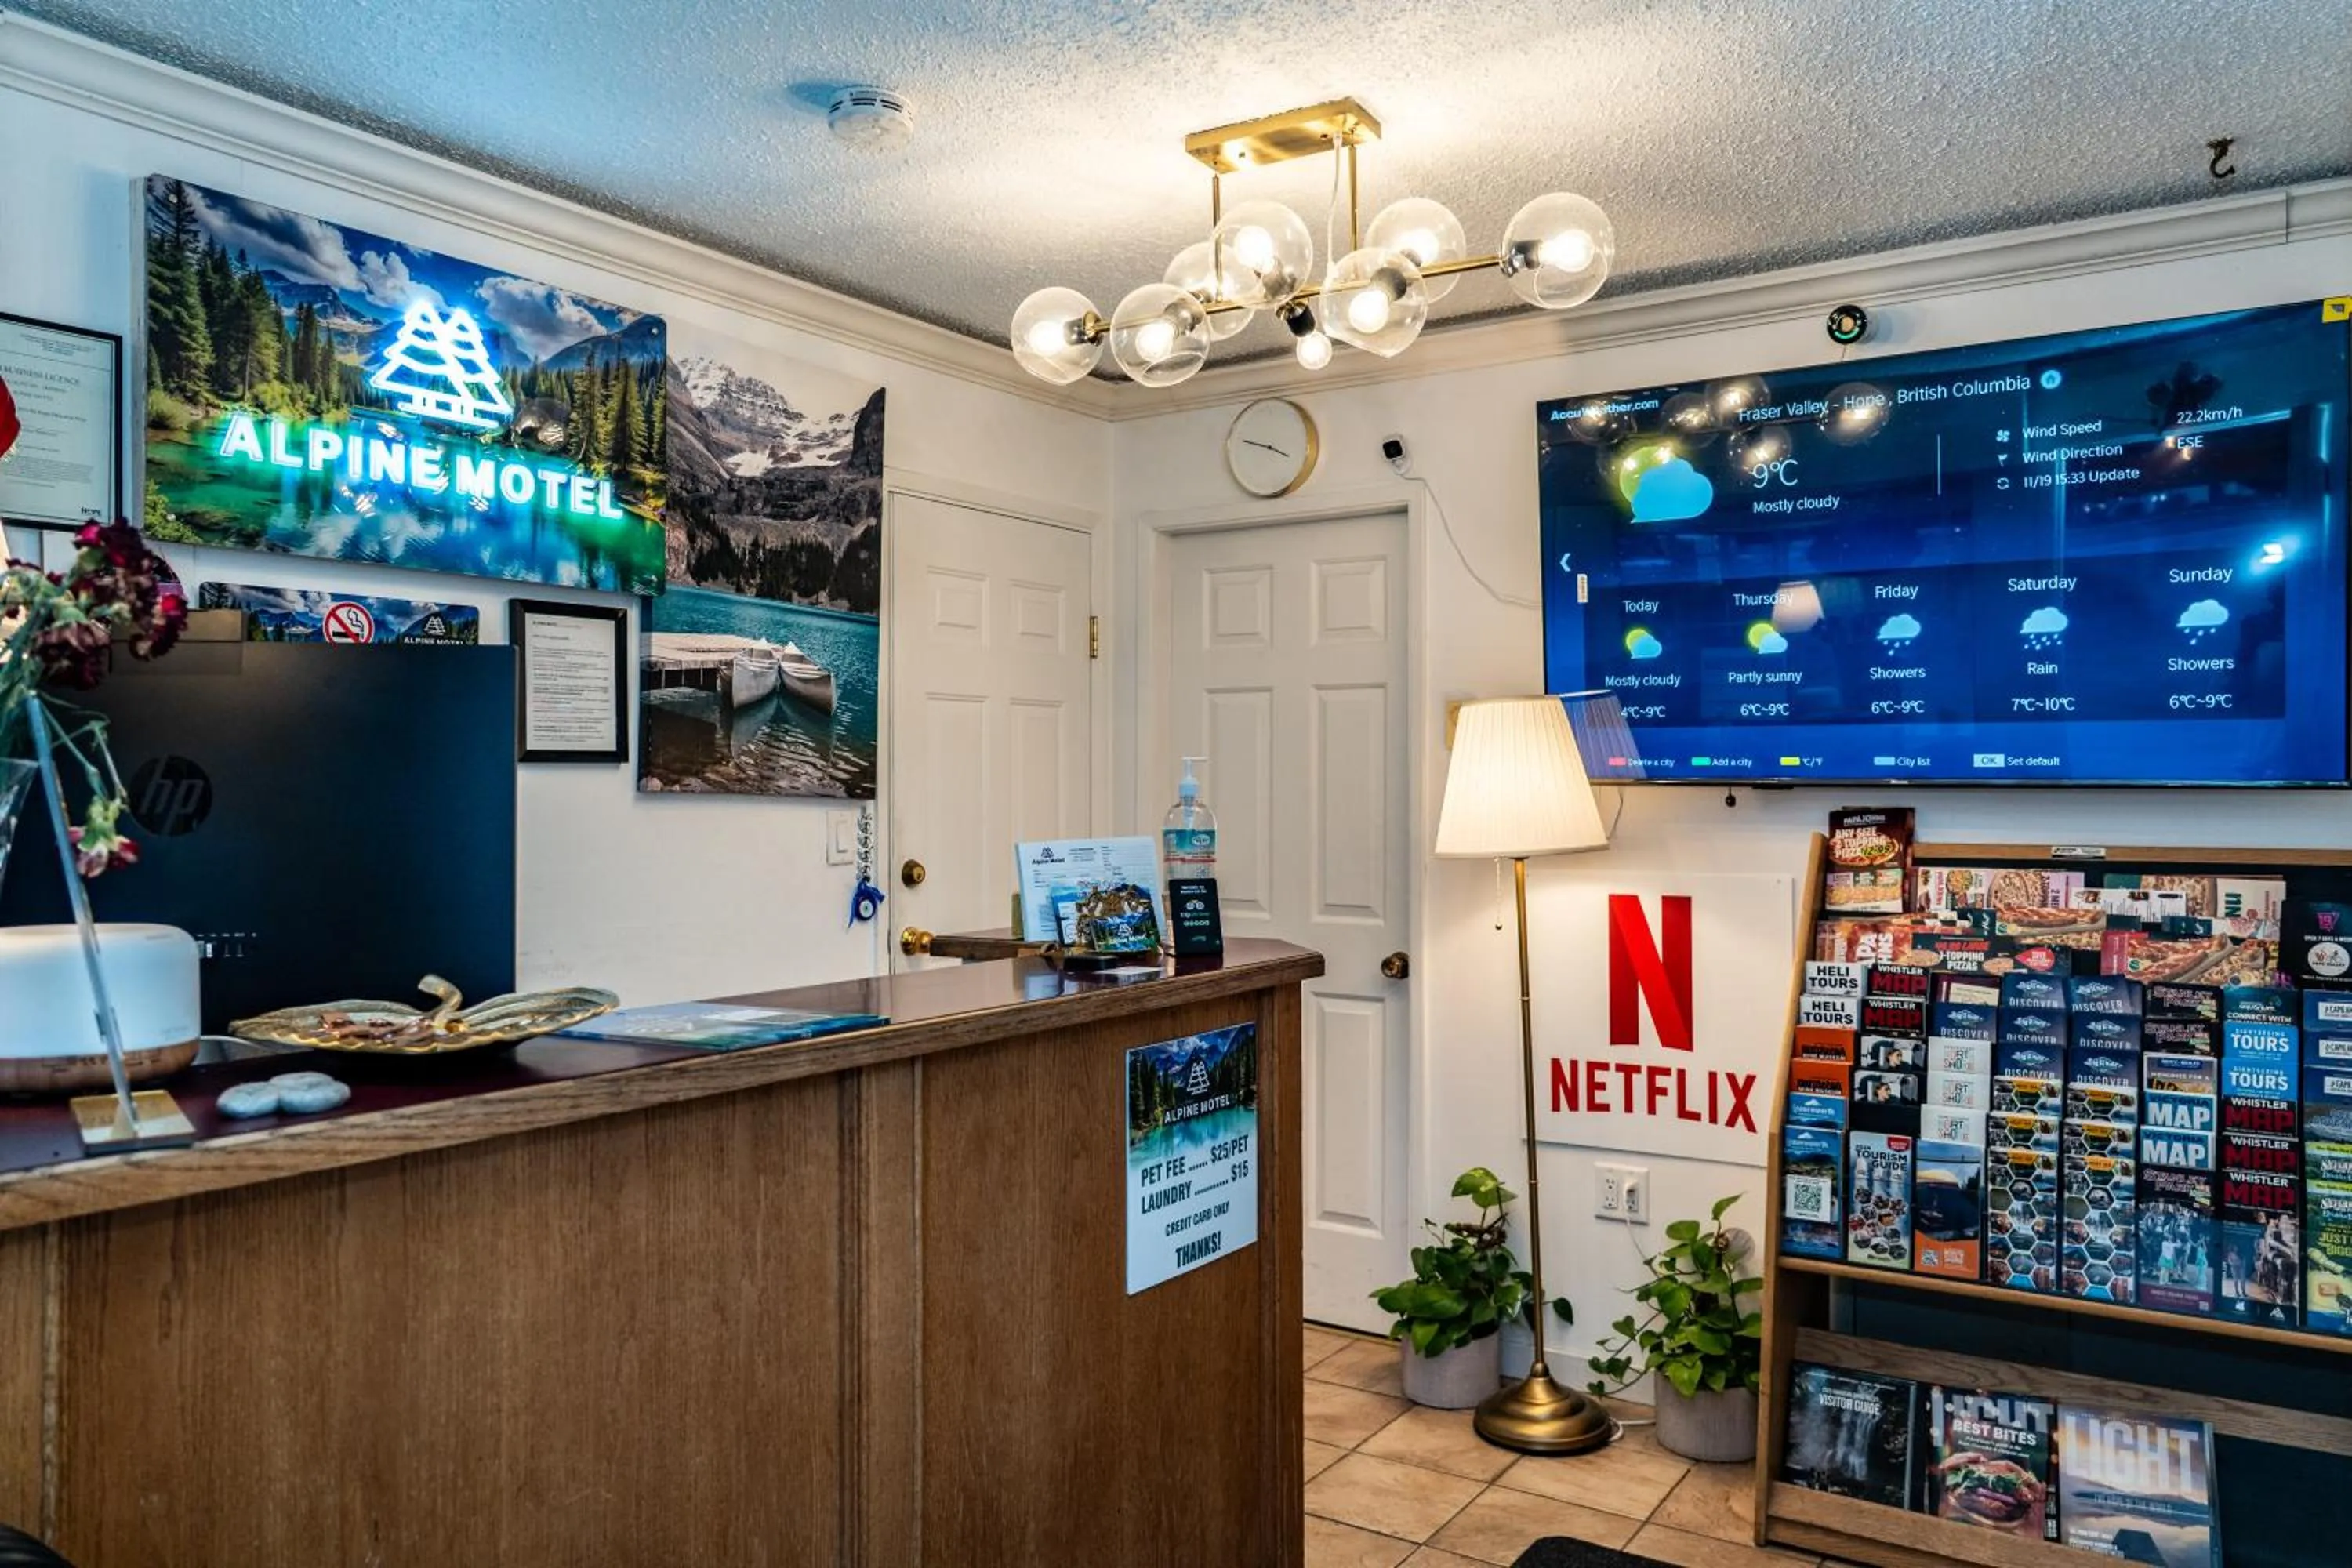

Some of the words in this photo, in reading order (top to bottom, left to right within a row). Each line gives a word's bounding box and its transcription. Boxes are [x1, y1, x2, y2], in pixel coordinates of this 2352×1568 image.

[1738, 405, 1783, 423] Fraser
[1786, 399, 1828, 419] Valley
[1844, 391, 1885, 413] Hope
[1897, 383, 1947, 404] British
[1952, 376, 2031, 398] Columbia
[1551, 399, 1659, 421] Accuther.com
[2176, 406, 2243, 424] 22.2km/h
[2022, 425, 2056, 440] Wind
[2060, 420, 2103, 437] Speed
[2176, 436, 2204, 449] ESE
[2022, 450, 2056, 464] Wind
[2060, 443, 2123, 460] Direction
[219, 412, 445, 490] ALPINE
[456, 454, 624, 519] MOTEL
[2024, 474, 2052, 488] 11/19
[2055, 471, 2085, 486] 15:33
[2089, 467, 2140, 485] Update
[1753, 498, 1794, 514] Mostly
[1796, 494, 1840, 514] cloudy
[2169, 567, 2233, 583] Sunday
[2008, 576, 2077, 593] Saturday
[1733, 591, 1794, 607] Thursday
[1875, 585, 1918, 600] Friday
[1624, 599, 1658, 614] Today
[2027, 662, 2058, 675] Rain
[2168, 657, 2234, 671] Showers
[1605, 674, 1640, 688] Mostly
[1642, 673, 1681, 688] cloudy
[1728, 670, 1762, 685] Partly
[1765, 670, 1802, 684] sunny
[1869, 666, 1926, 680] Showers
[1661, 758, 1675, 768] city
[1737, 758, 1752, 768] city
[1897, 757, 1915, 768] City
[1917, 757, 1931, 766] list
[1980, 756, 1998, 765] OK
[2006, 756, 2025, 766] Set
[2027, 756, 2060, 767] default
[139, 755, 205, 836] hp
[1609, 894, 1693, 1051] N
[1817, 965, 1849, 978] HELI
[1878, 966, 1923, 975] WHISTLER
[1947, 960, 1979, 971] PIZZAS
[1809, 977, 1858, 989] TOURS
[1872, 973, 1927, 993] MAP
[1812, 1000, 1845, 1013] HELI
[1870, 1000, 1915, 1010] WHISTLER
[2009, 996, 2058, 1007] DISCOVER
[2072, 1000, 2122, 1012] DISCOVER
[1804, 1012, 1853, 1025] TOURS
[1864, 1008, 1920, 1027] MAP
[1940, 1027, 1989, 1039] DISCOVER
[2006, 1033, 2057, 1044] DISCOVER
[2080, 1037, 2132, 1050] DISCOVER
[2230, 1033, 2289, 1052] TOURS
[2005, 1067, 2056, 1079] DISCOVER
[2077, 1074, 2129, 1087] DISCOVER
[2228, 1071, 2288, 1091] TOURS
[1551, 1057, 1757, 1134] NETFLIX
[1164, 1102, 1199, 1123] ALPINE
[1200, 1094, 1230, 1115] MOTEL
[2230, 1097, 2288, 1110] WHISTLER
[2147, 1101, 2210, 1129] MAP
[2224, 1105, 2294, 1132] MAP
[2230, 1136, 2289, 1150] WHISTLER
[1141, 1163, 1163, 1187] PET
[1166, 1156, 1186, 1178] FEE
[1210, 1134, 1249, 1164] $25/PET
[1856, 1150, 1907, 1163] TOURISM
[2143, 1139, 2205, 1167] MAP
[2224, 1145, 2296, 1171] MAP
[1871, 1160, 1907, 1172] GUIDE
[1141, 1180, 1192, 1214] LAUNDRY
[1231, 1160, 1249, 1183] $15
[2229, 1172, 2289, 1187] WHISTLER
[2224, 1182, 2296, 1210] MAP
[1165, 1216, 1191, 1236] CREDIT
[1193, 1208, 1213, 1228] CARD
[1214, 1200, 1229, 1221] ONLY
[1175, 1231, 1221, 1268] THANKS!
[1820, 1393, 1853, 1410] VISITOR
[1854, 1399, 1881, 1415] GUIDE
[1952, 1418, 1991, 1437] BEST
[1994, 1426, 2037, 1446] BITES
[2065, 1415, 2199, 1493] LIGHT
